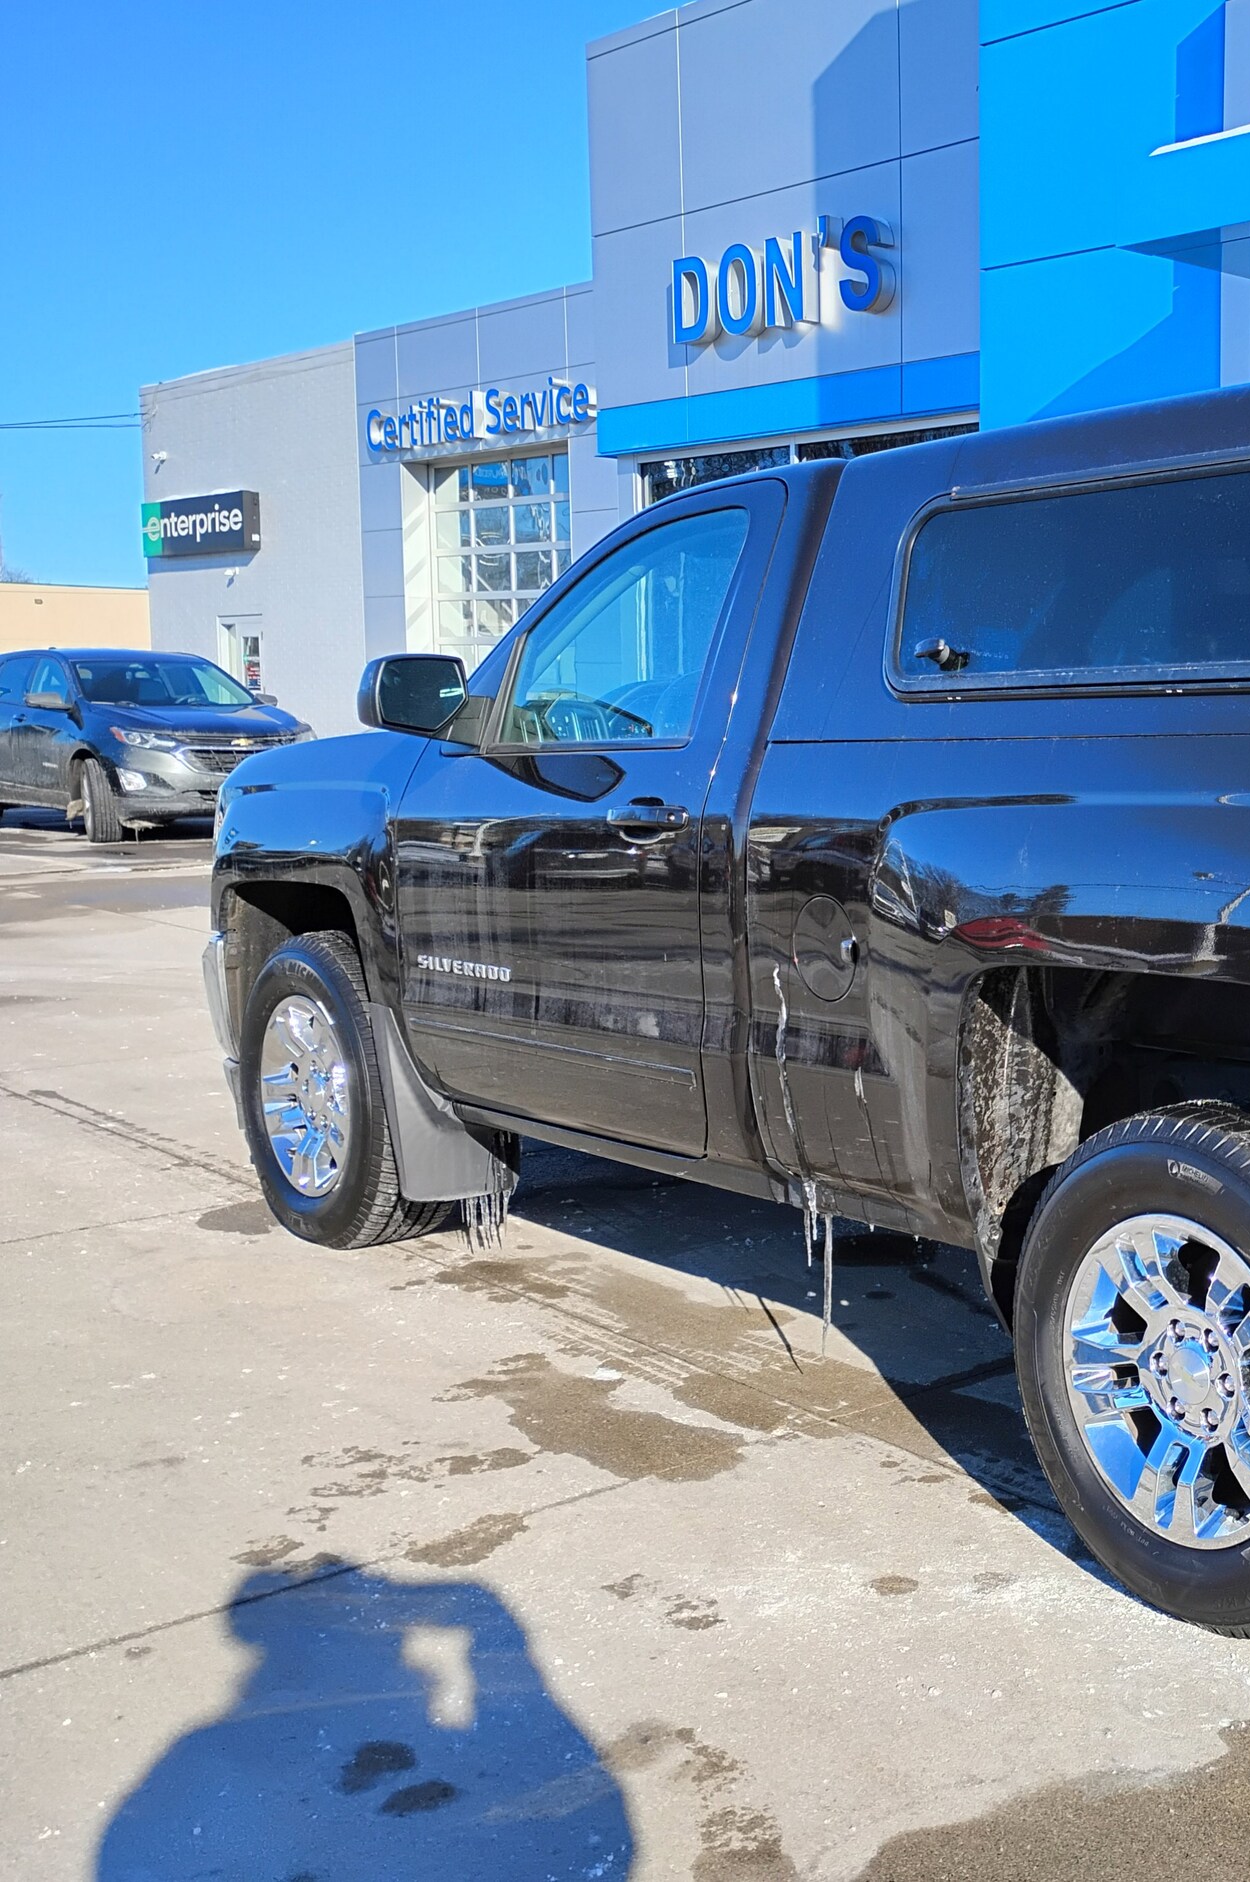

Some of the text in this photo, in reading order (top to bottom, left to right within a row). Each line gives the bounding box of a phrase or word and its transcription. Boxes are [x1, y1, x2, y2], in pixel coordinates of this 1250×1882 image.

[671, 214, 884, 344] DON'S
[366, 376, 592, 451] Certified Service
[145, 503, 243, 543] enterprise
[417, 954, 512, 983] SILVERADO
